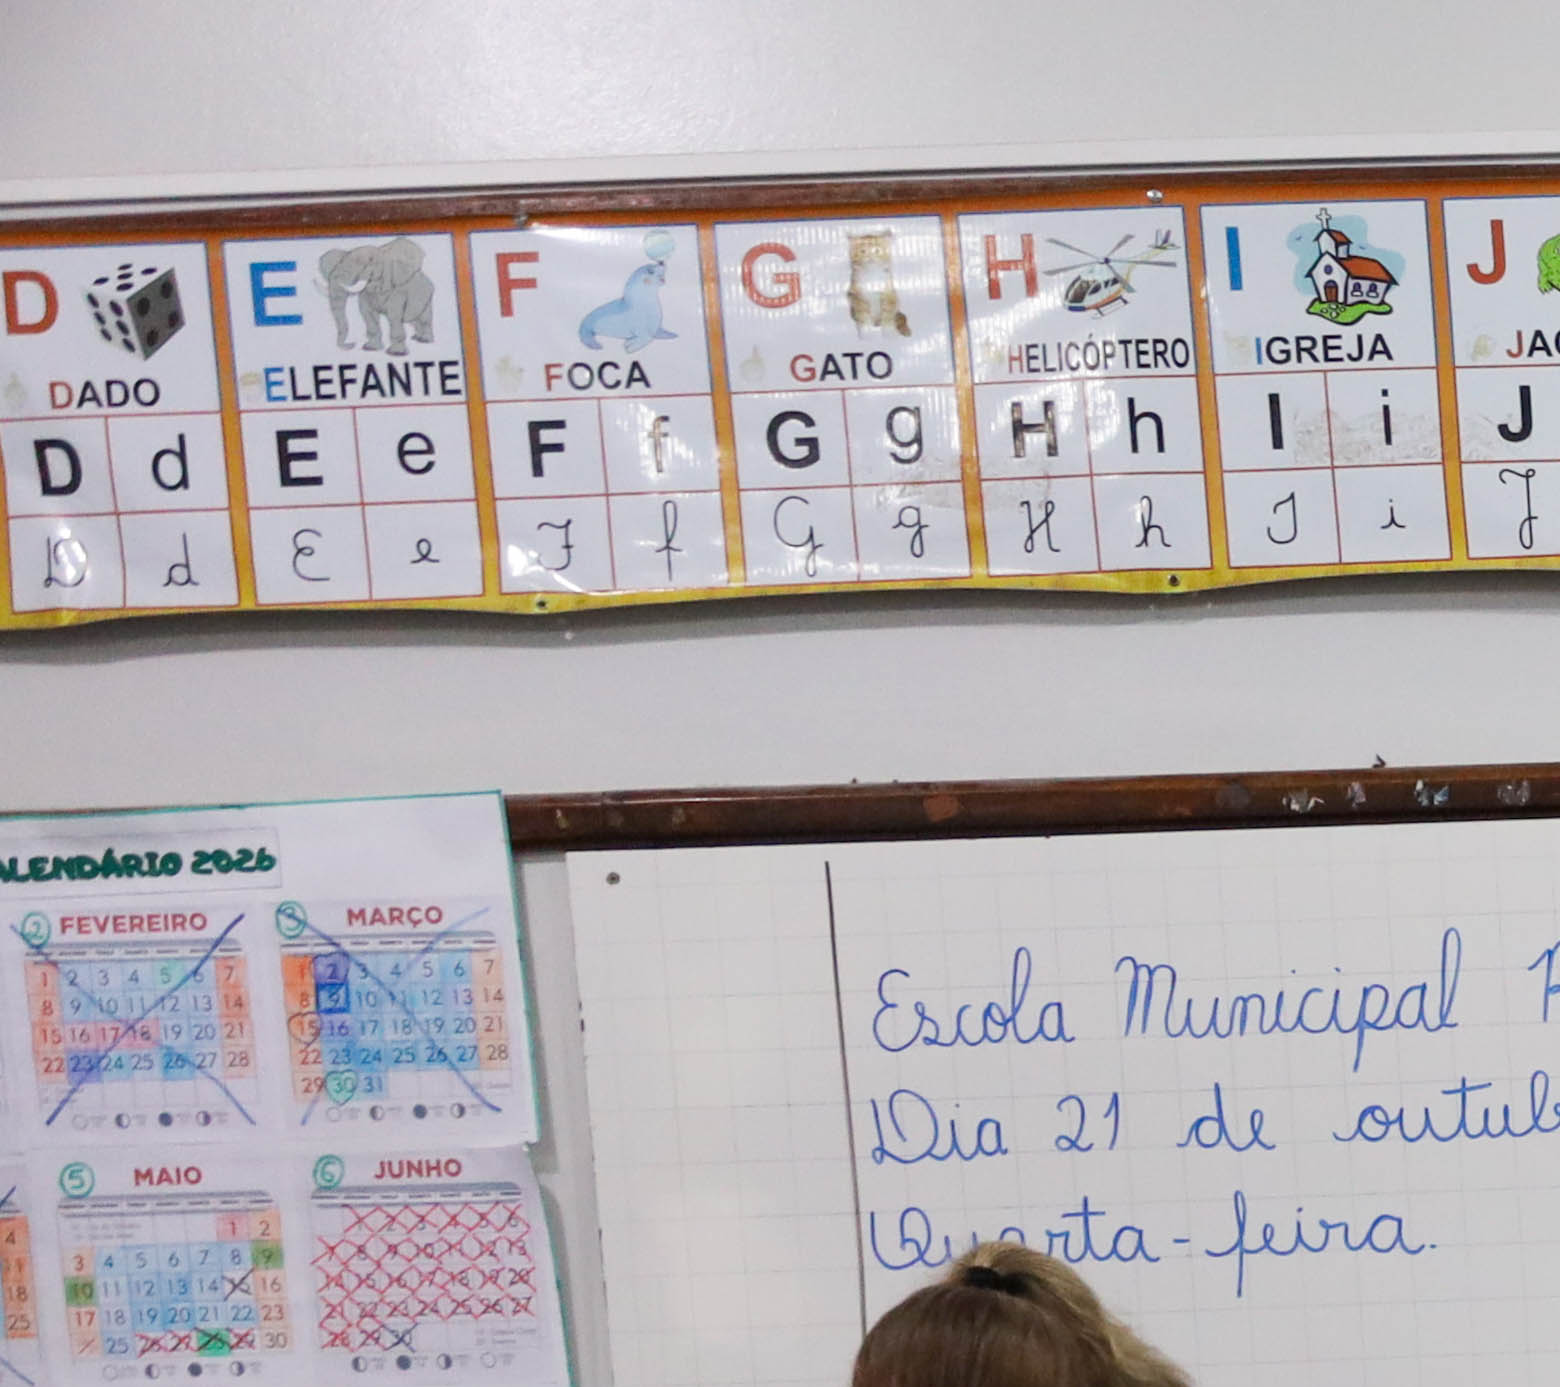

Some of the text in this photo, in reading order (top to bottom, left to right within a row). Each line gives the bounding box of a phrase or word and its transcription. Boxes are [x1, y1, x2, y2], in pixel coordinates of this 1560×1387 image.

[1006, 330, 1190, 377] HELICÓPTERO
[1254, 328, 1395, 366] IGREJA
[262, 360, 463, 405] ELEFANTE
[543, 358, 651, 393] FOCA
[789, 350, 894, 385] GATO
[48, 379, 160, 411] DADO
[192, 847, 276, 874] 2026
[60, 913, 207, 934] FEVEREIRO
[346, 906, 444, 928] MARÇO
[870, 946, 1077, 1055] Escola
[1115, 927, 1462, 1074] Municipal
[868, 1094, 1009, 1167] Dia
[1055, 1094, 1123, 1152] 21
[1175, 1082, 1279, 1152] de
[134, 1166, 202, 1186] MAIO
[374, 1158, 462, 1179] JUNHO
